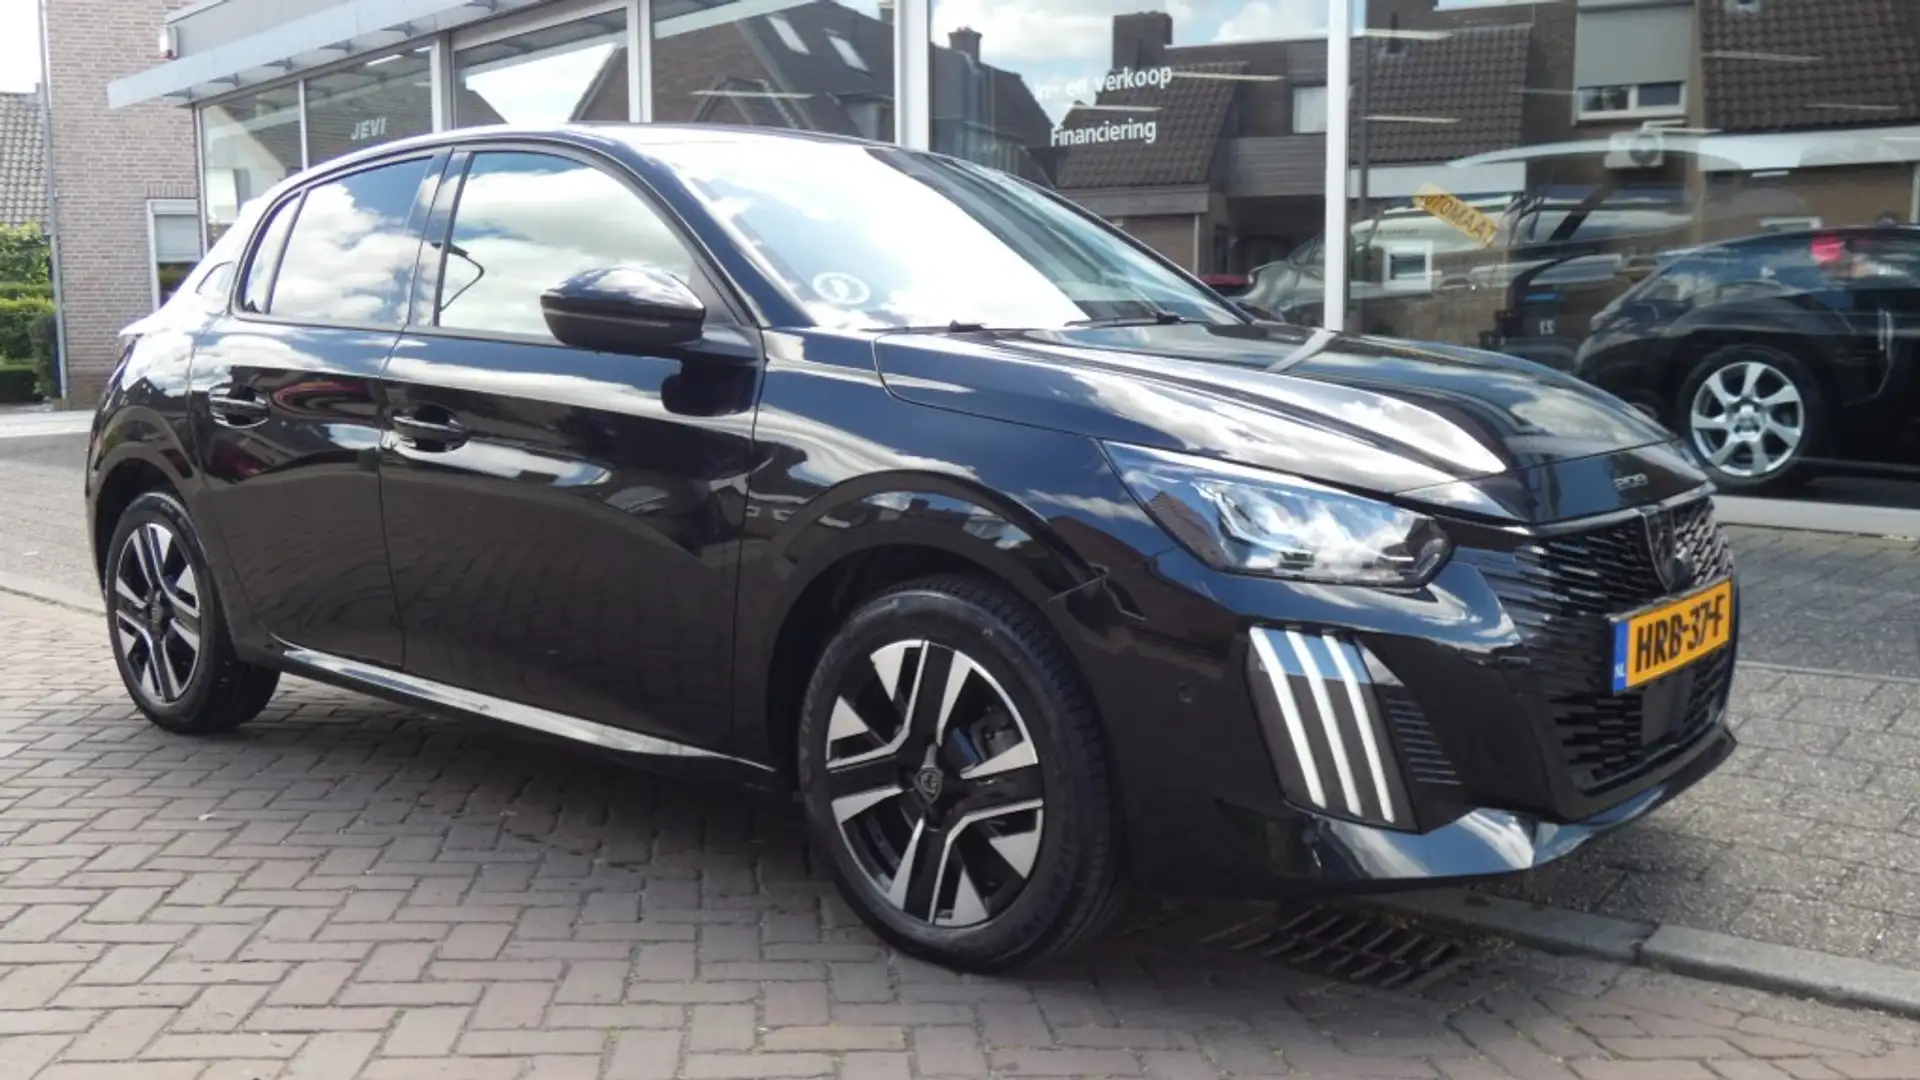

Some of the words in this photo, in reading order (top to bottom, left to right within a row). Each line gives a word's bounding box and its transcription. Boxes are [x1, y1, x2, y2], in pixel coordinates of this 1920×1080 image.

[1065, 78, 1088, 97] en
[1094, 66, 1173, 92] verkoop
[350, 117, 387, 140] JEVI
[1050, 117, 1157, 147] Financiering
[1635, 593, 1726, 674] HRB-37-F
[1614, 662, 1626, 679] NL
